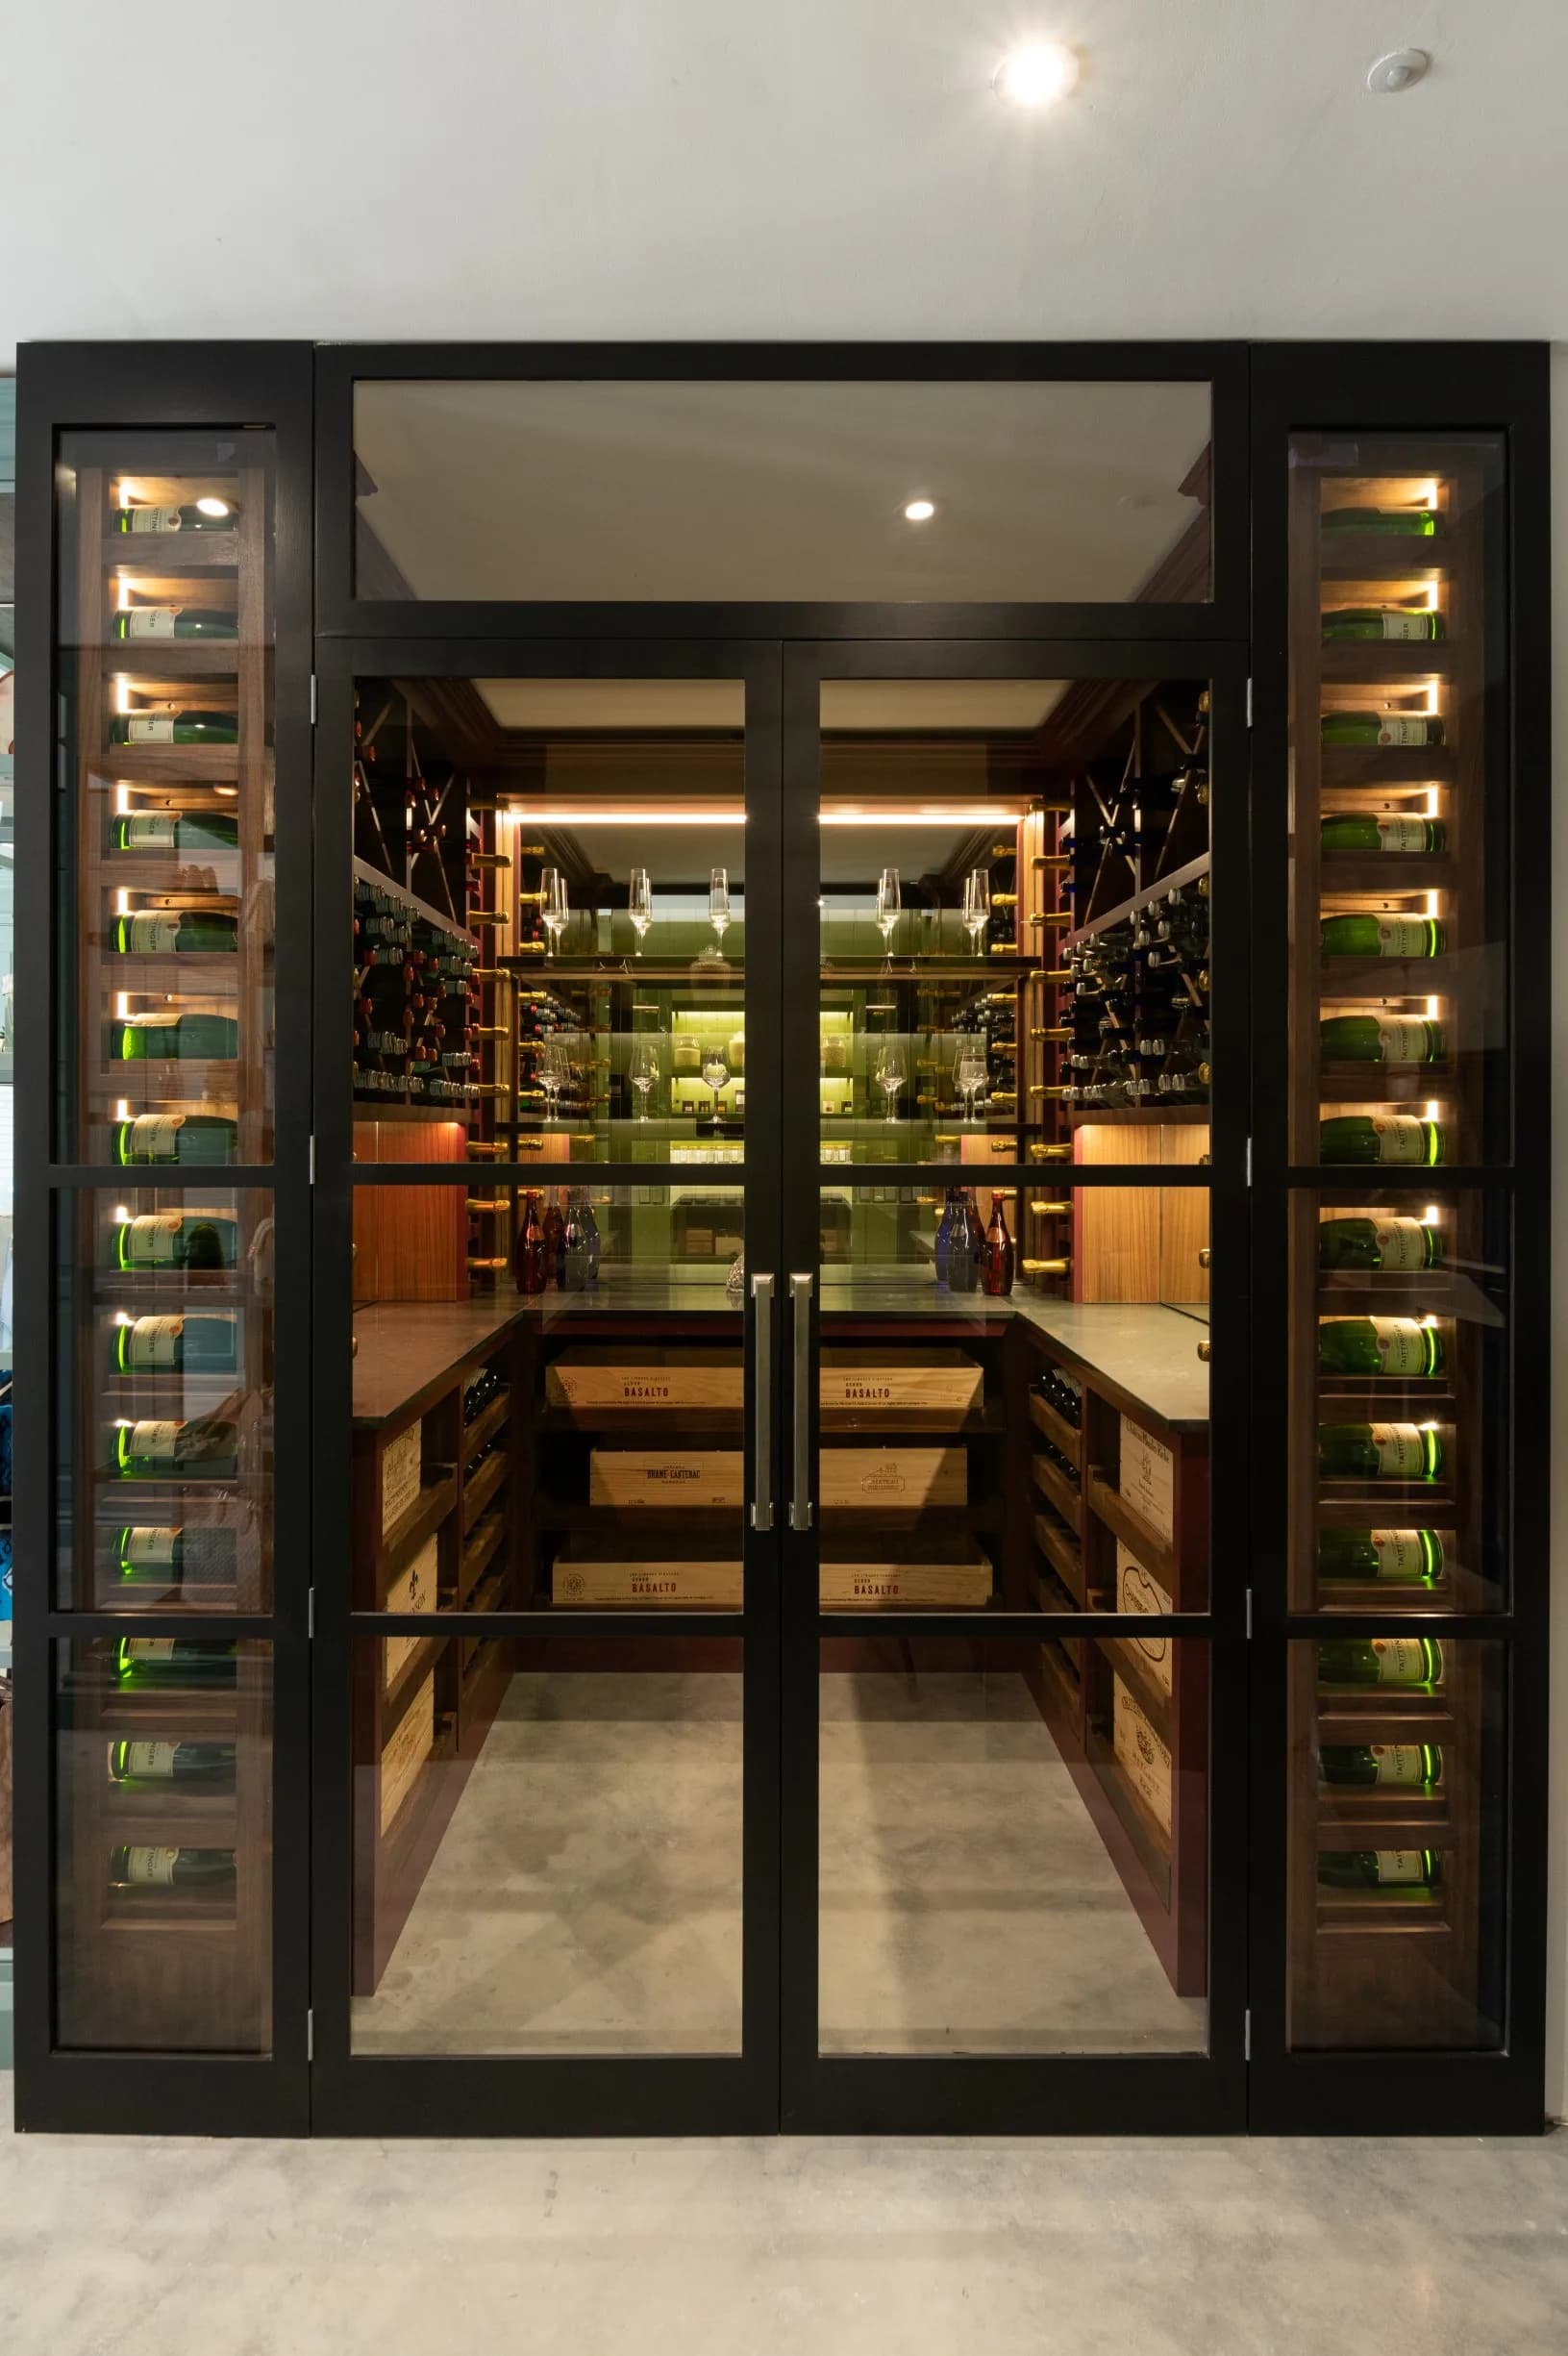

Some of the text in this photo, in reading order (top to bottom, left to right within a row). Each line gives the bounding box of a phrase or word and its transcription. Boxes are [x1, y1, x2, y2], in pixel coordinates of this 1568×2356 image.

[624, 1387, 668, 1397] BASALTO
[845, 1388, 890, 1398] BASALTO
[632, 1583, 677, 1592] BASALTO
[854, 1585, 899, 1594] BASALTO
